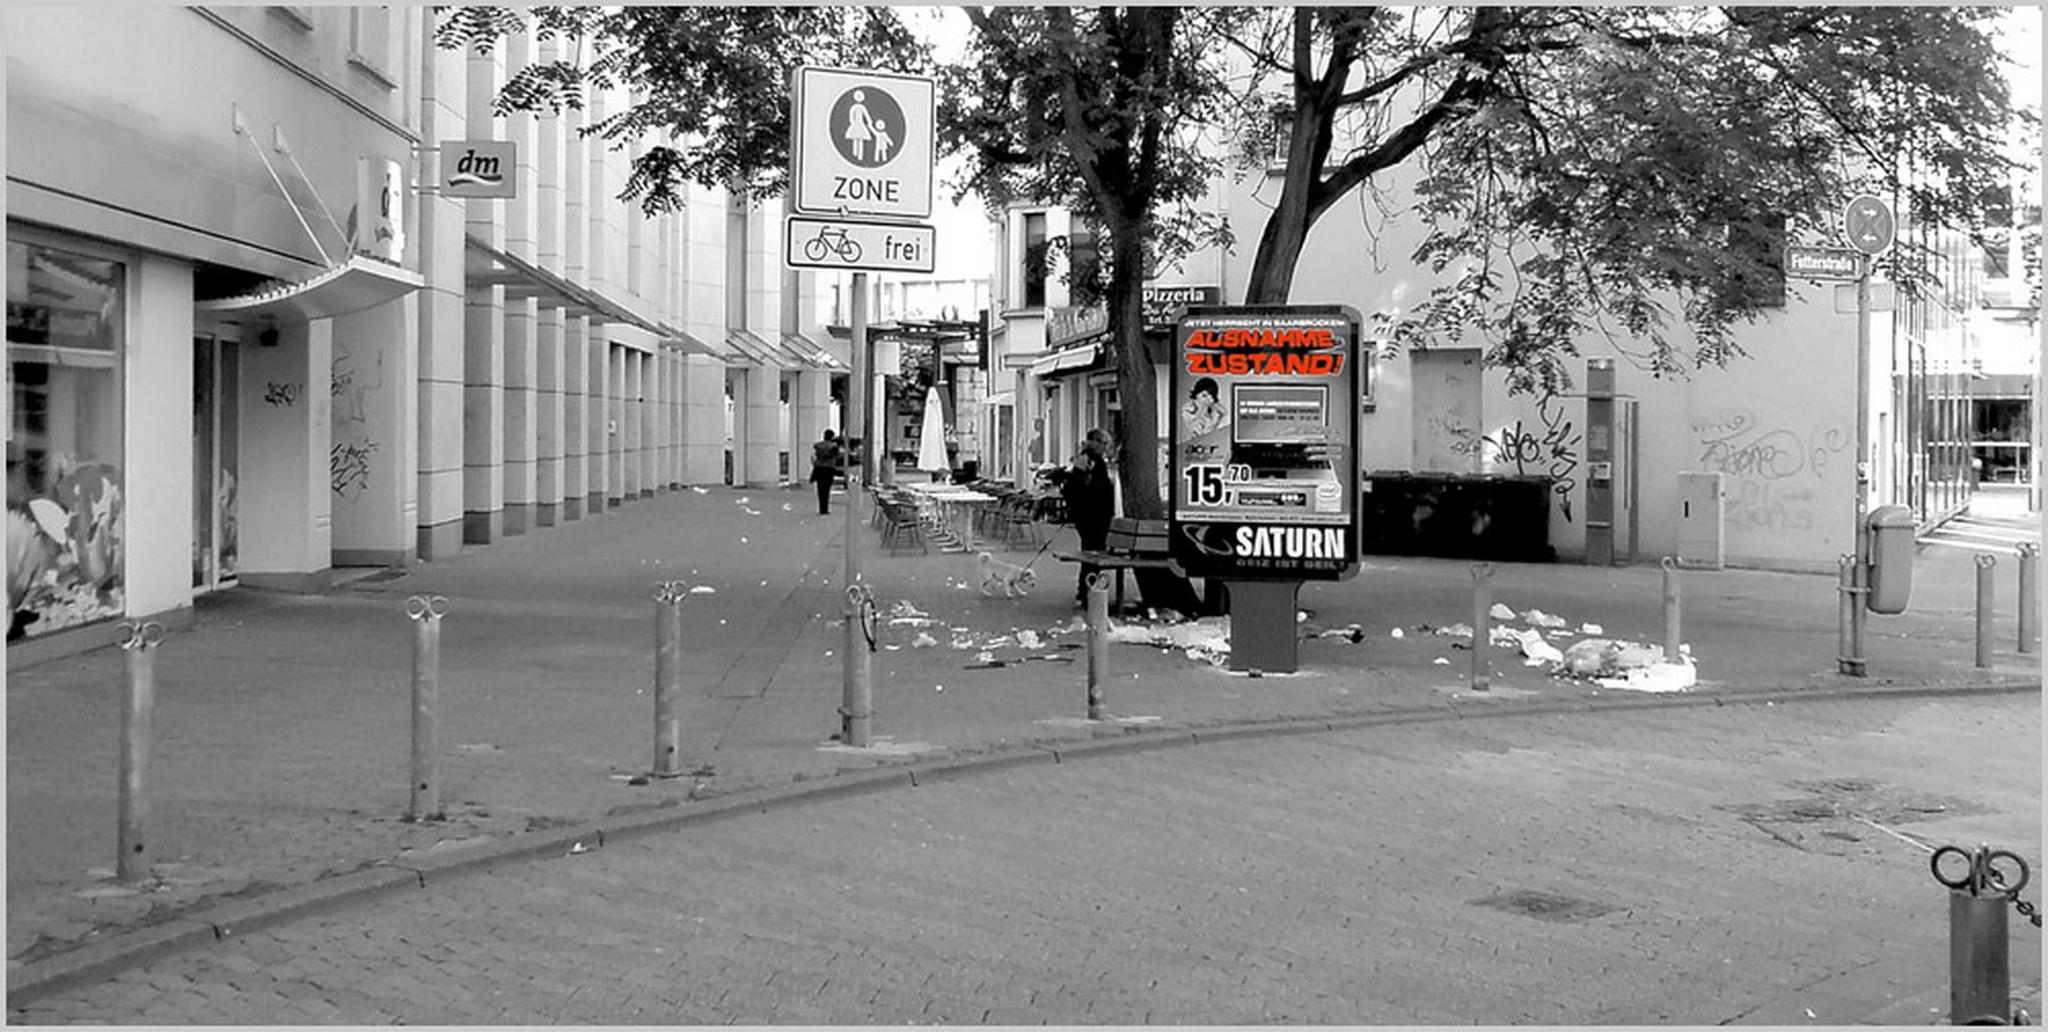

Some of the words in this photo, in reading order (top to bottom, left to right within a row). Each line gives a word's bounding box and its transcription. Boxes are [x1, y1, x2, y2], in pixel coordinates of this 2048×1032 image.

[457, 149, 500, 174] dm
[833, 176, 899, 203] ZONE
[885, 235, 921, 261] frei
[1142, 288, 1206, 302] Pizzeria
[1185, 353, 1344, 375] ZUSTAND!
[1236, 526, 1345, 559] SATURN
[1236, 559, 1270, 568] GEIZ
[1275, 559, 1298, 569] IST
